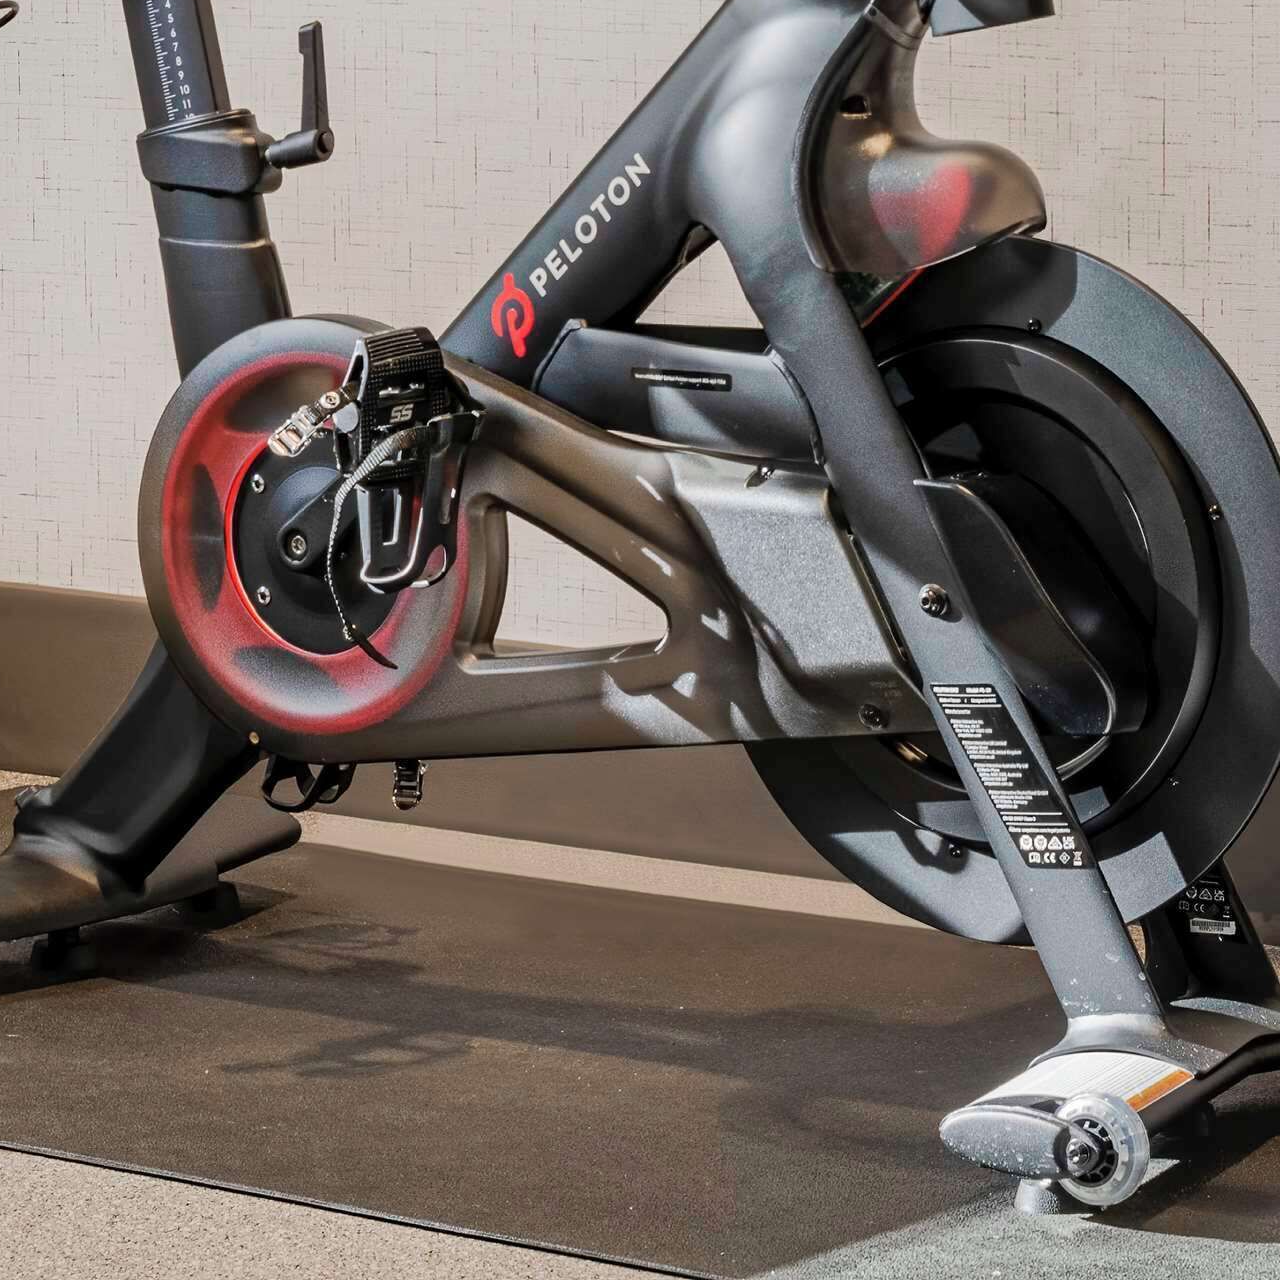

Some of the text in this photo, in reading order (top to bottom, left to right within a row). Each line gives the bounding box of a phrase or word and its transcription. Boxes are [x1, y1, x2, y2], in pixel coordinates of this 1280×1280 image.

[165, 0, 171, 8] 4
[167, 13, 174, 23] 5
[170, 28, 176, 37] 6
[172, 42, 178, 52] 7
[176, 56, 182, 66] 8
[178, 71, 184, 80] 9
[180, 85, 190, 95] 10
[183, 99, 192, 109] 11
[529, 153, 651, 297] PELOTON
